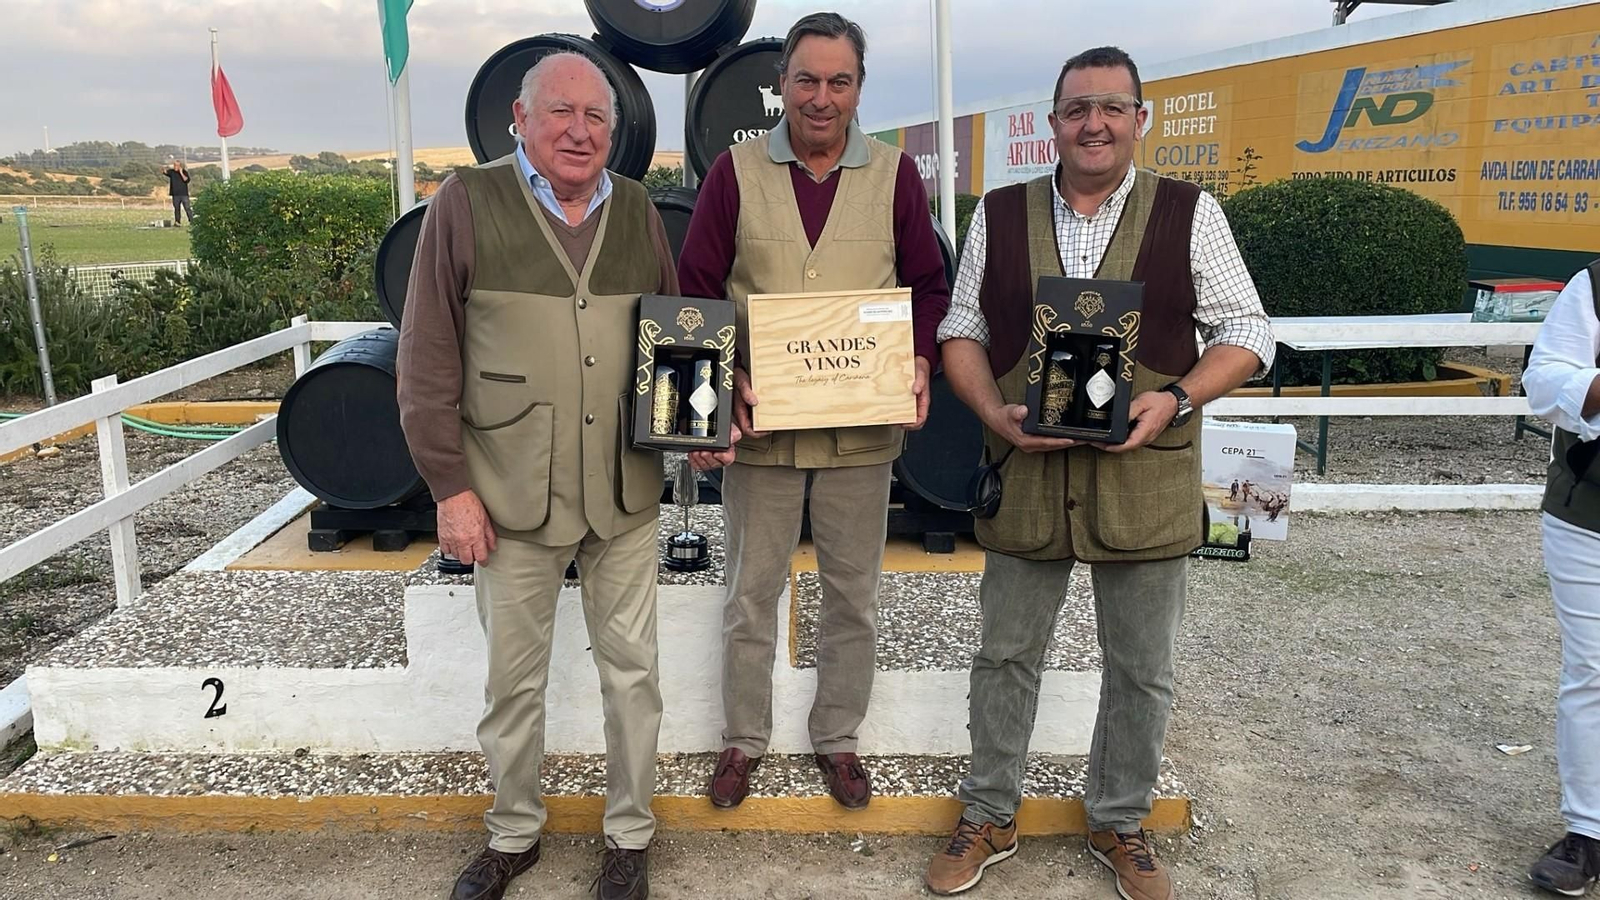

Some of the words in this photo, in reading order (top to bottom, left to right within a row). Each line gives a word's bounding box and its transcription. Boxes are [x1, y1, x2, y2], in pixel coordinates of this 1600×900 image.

[1499, 78, 1556, 95] ART
[1163, 92, 1218, 115] HOTEL
[1007, 111, 1035, 138] BAR
[1162, 116, 1217, 137] BUFFET
[1007, 138, 1058, 166] ARTURO
[1155, 144, 1219, 167] GOLPE
[1357, 171, 1373, 182] DE
[1375, 168, 1457, 182] ARTICULOS
[1481, 161, 1508, 180] AVDA
[1511, 160, 1538, 180] LEON
[1540, 160, 1555, 180] DE
[1518, 192, 1537, 211] 956
[1541, 192, 1552, 211] 18
[1555, 193, 1568, 212] 54
[1574, 192, 1588, 213] 93
[786, 336, 877, 355] GRANDES
[804, 354, 861, 371] VINOS
[794, 375, 806, 385] The
[1221, 447, 1244, 455] CEPA
[1246, 448, 1256, 456] 21
[201, 677, 227, 719] 2
